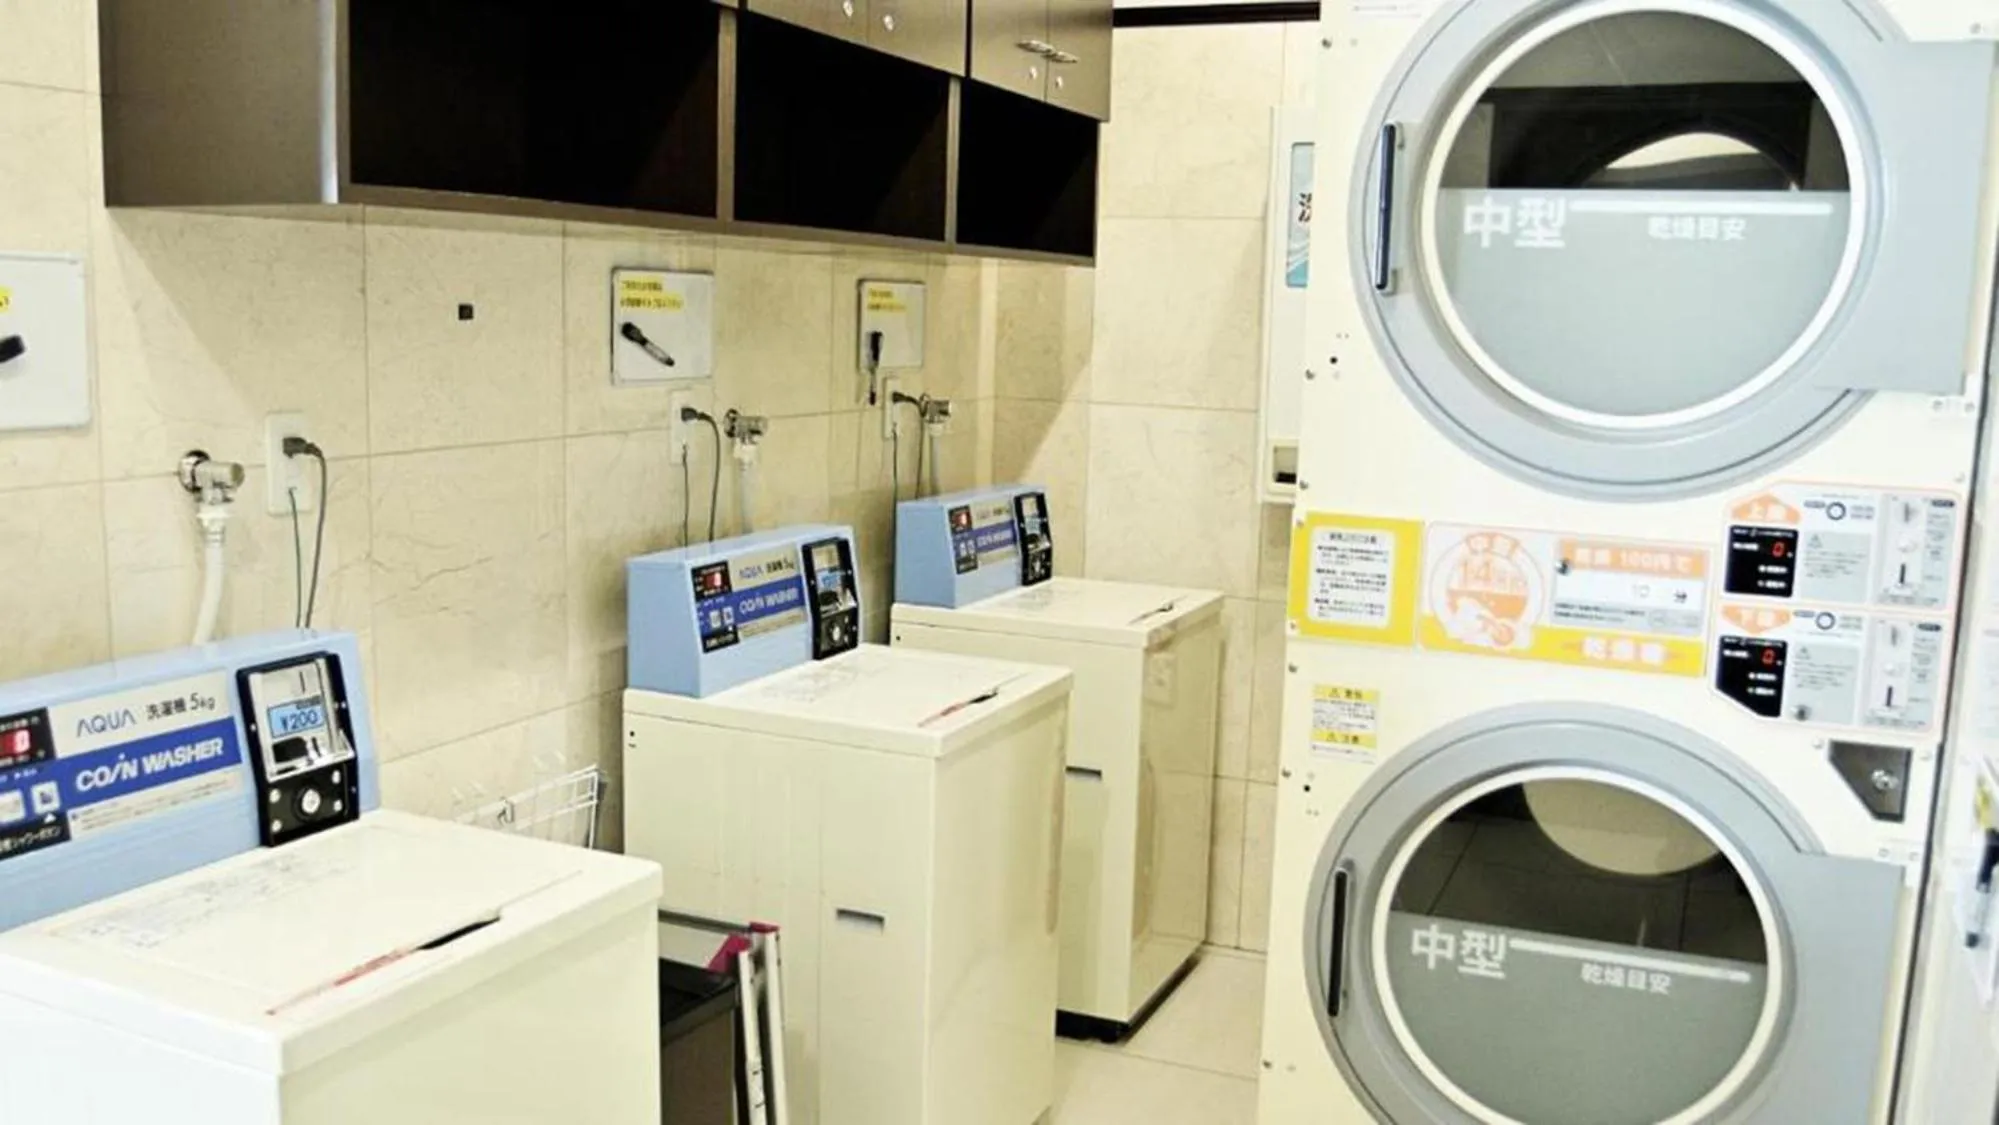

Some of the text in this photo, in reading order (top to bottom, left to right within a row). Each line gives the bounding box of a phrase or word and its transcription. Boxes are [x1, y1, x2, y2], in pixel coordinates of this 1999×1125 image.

[1463, 195, 1566, 249] 中型
[1647, 215, 1747, 241] 乾燥目安
[1772, 541, 1785, 557] 0
[1763, 648, 1775, 665] 0
[146, 692, 216, 721] 洗濯機 5kg
[76, 709, 138, 738] AQUA
[142, 737, 224, 775] WASHER
[1411, 923, 1508, 980] 中型
[1579, 961, 1672, 995] 乾燥目安
